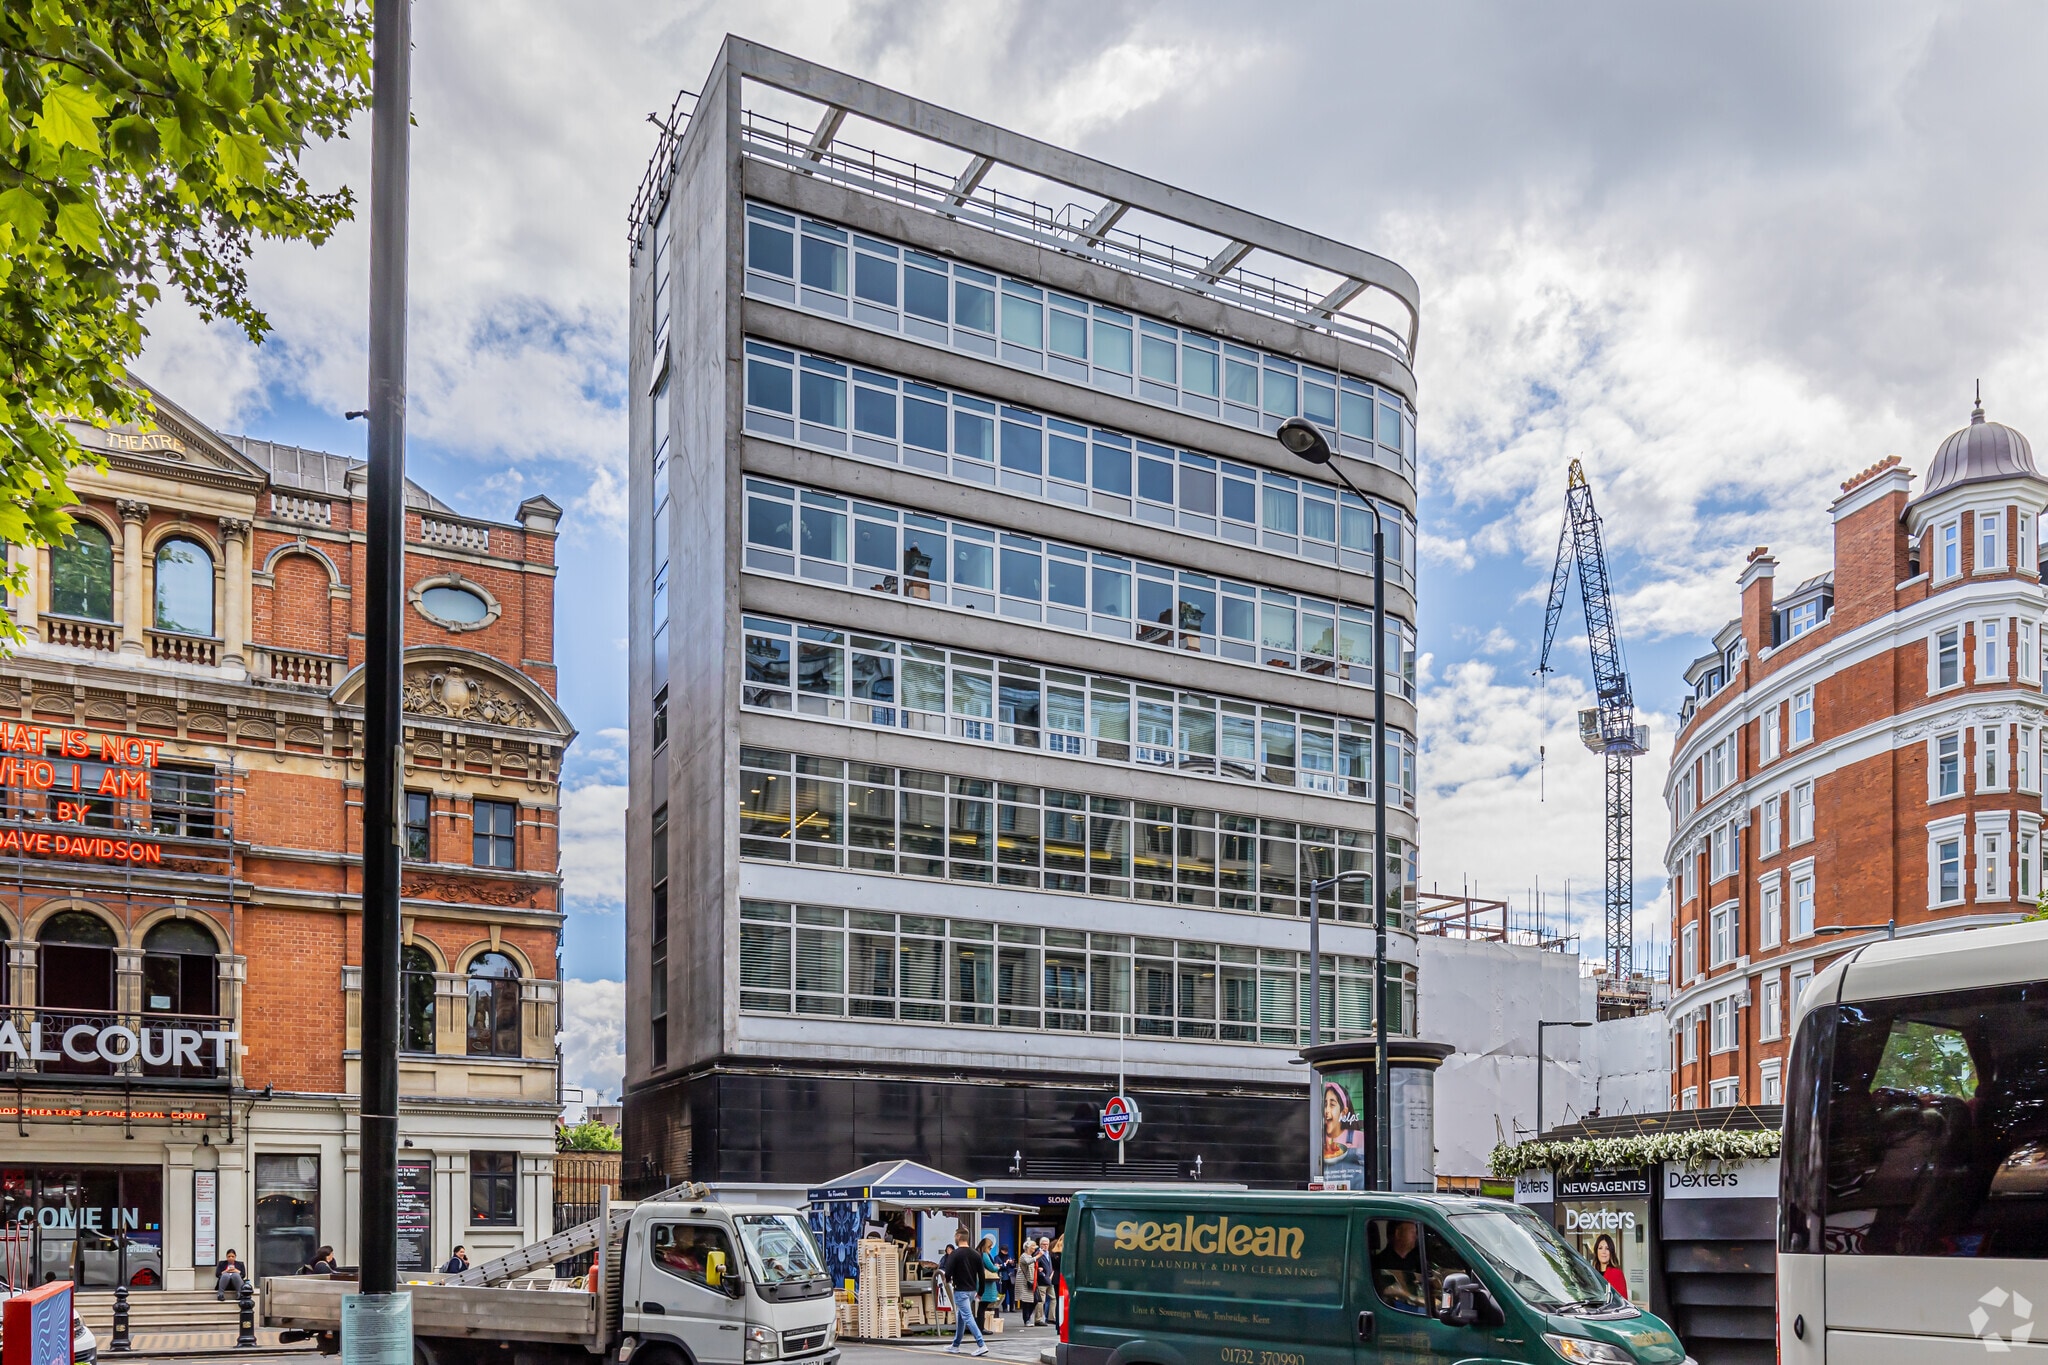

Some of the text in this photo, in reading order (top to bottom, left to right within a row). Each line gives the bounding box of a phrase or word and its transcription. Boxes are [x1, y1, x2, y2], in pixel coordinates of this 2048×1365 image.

[108, 432, 182, 452] THEATRE
[60, 729, 90, 757] IS
[101, 734, 164, 767] NOT
[72, 764, 80, 792] I
[98, 768, 147, 799] AM
[58, 802, 91, 823] BY
[55, 835, 161, 863] DAVIDSON
[130, 1111, 165, 1119] ROYAL
[171, 1112, 206, 1120] COURT
[1103, 1115, 1128, 1123] UNDERGROUND
[1518, 1179, 1549, 1194] Dexters
[1563, 1180, 1646, 1194] NEWSAGENTS
[1048, 1196, 1071, 1204] SLOAN
[18, 1206, 138, 1230] COME IN
[1566, 1208, 1635, 1230] Dexters
[1114, 1215, 1305, 1260] sealclean
[1098, 1257, 1147, 1267] QUALITY
[1151, 1260, 1207, 1271] LAUNDRY
[1223, 1263, 1247, 1273] DRY
[1251, 1264, 1318, 1277] CLEANING
[1132, 1305, 1148, 1314] Unit
[1158, 1307, 1191, 1319] Sovereign
[1253, 1314, 1270, 1324] Kent
[1221, 1347, 1305, 1365] 01732 370990
